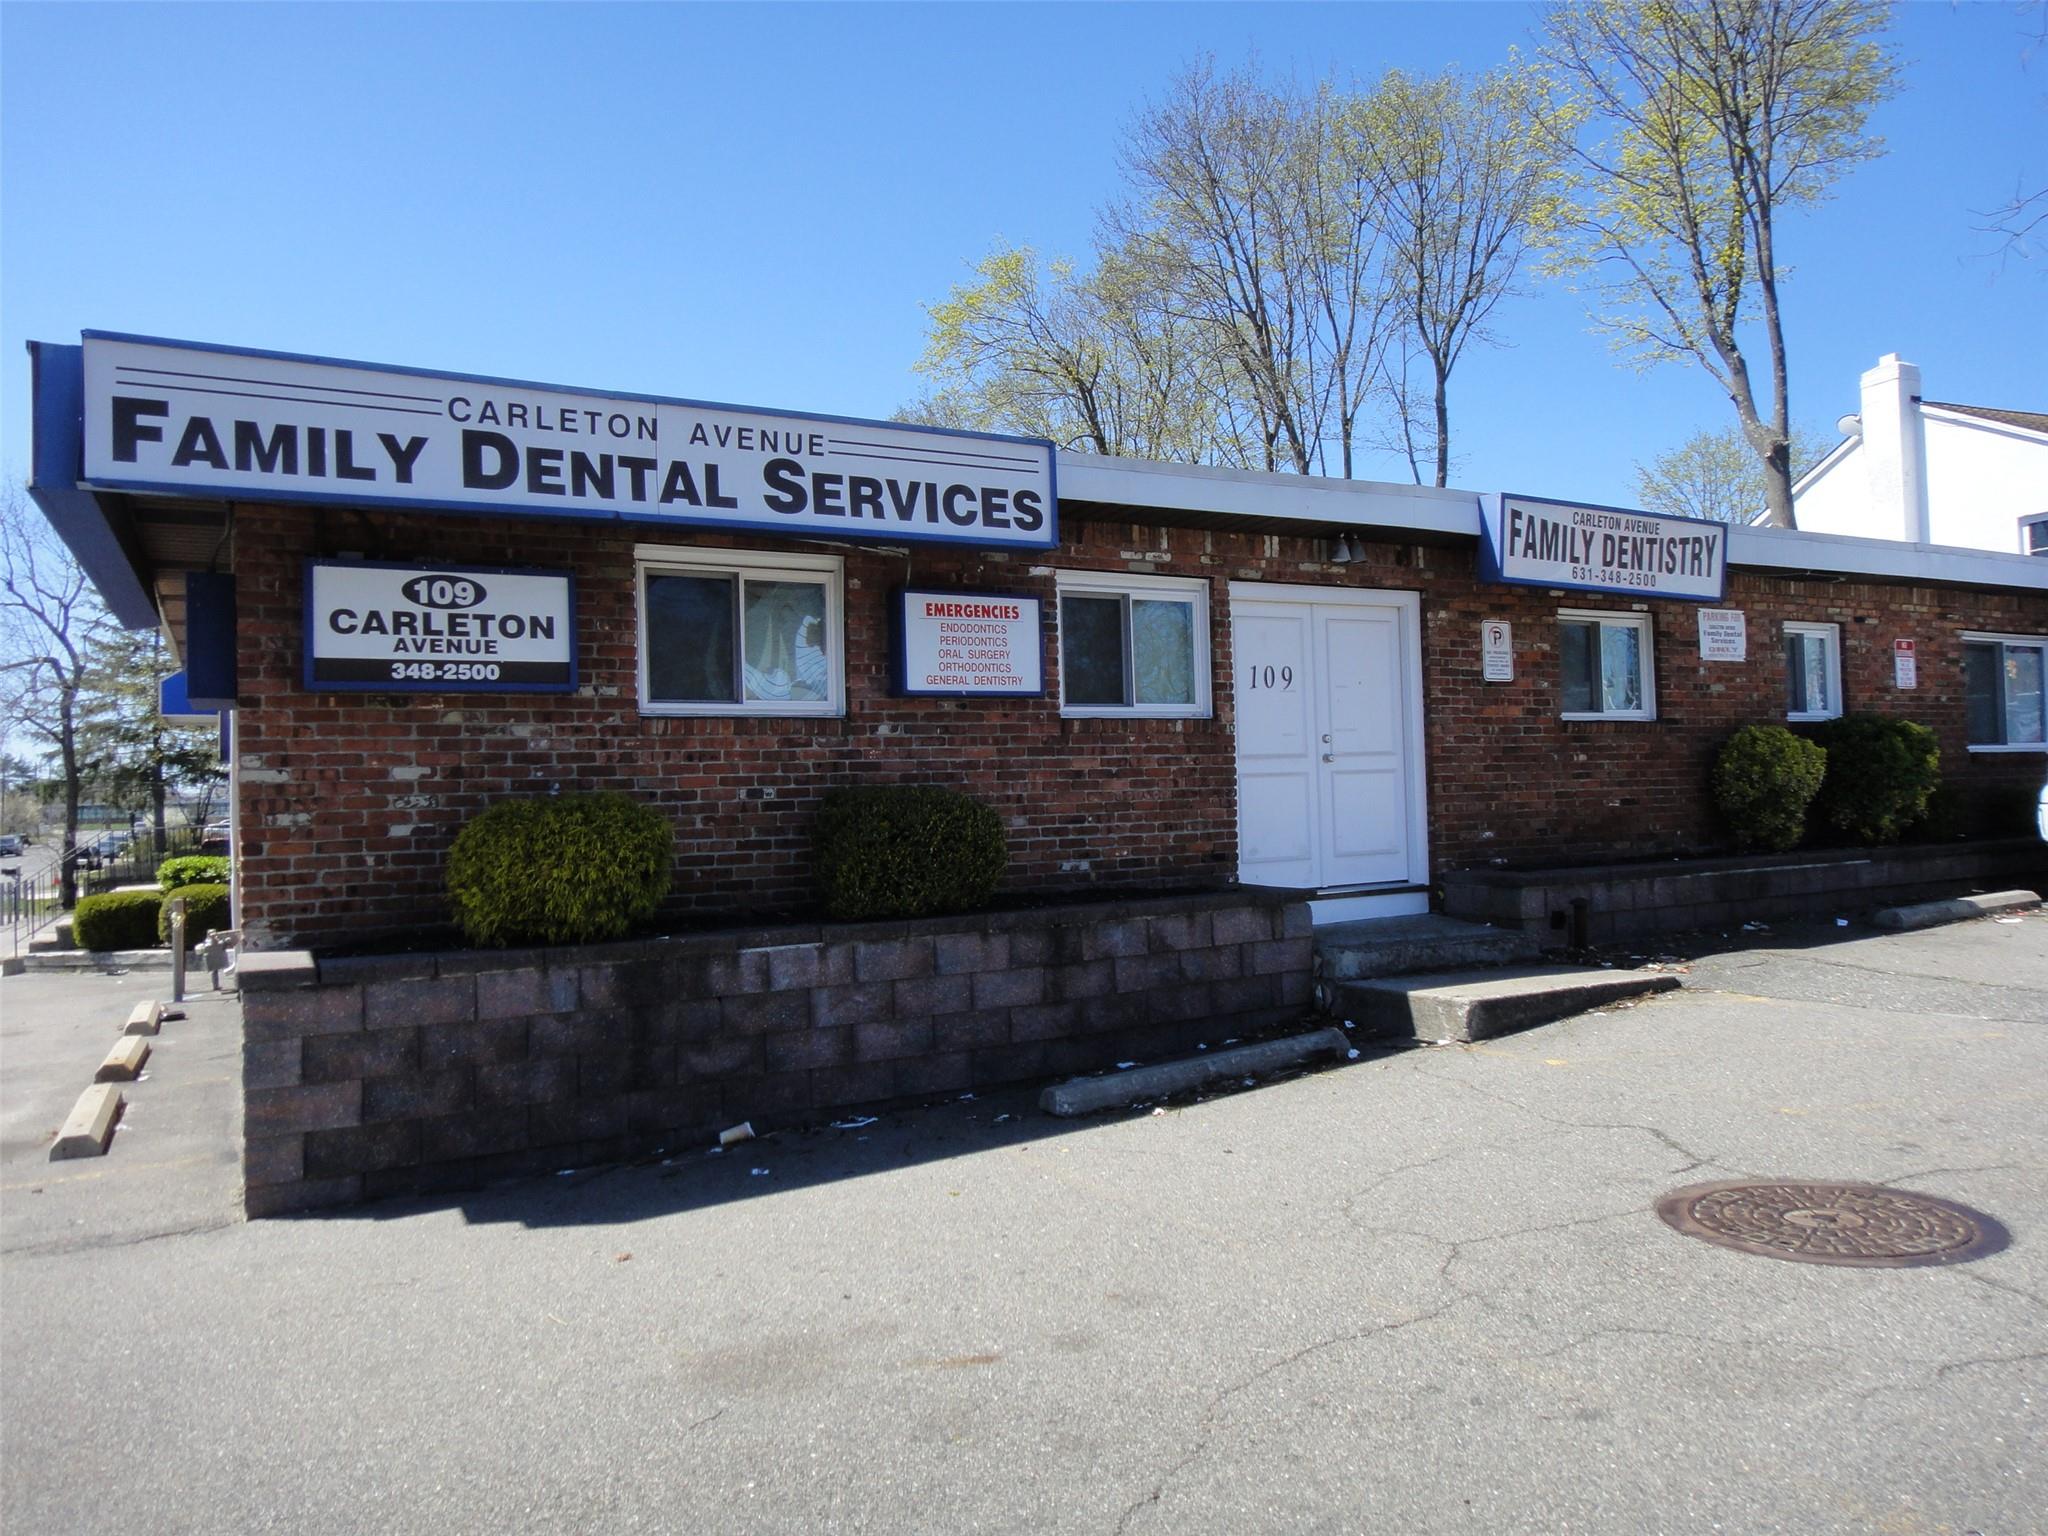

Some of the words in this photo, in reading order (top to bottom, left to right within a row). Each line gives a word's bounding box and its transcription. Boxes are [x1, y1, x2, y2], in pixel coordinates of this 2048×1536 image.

[447, 396, 658, 442] CARLETON
[689, 422, 826, 457] AVENUE
[111, 396, 428, 484] FAMILY
[462, 428, 738, 509] DENTAL
[762, 457, 1044, 532] SERVICES
[1572, 511, 1621, 530] CARLETON
[1624, 519, 1660, 536] AVENUE
[1509, 508, 1595, 565] FAMILY
[1602, 533, 1717, 578] DENTISTRY
[1572, 566, 1657, 588] 631-348-2500
[413, 579, 473, 606] 109
[925, 602, 1020, 619] EMERGENCIES
[328, 607, 555, 641] CARLETON
[940, 623, 1008, 634] ENDODONTICS
[392, 637, 498, 654] AVENUE
[939, 635, 1008, 647] PERIODONTICS
[938, 649, 963, 659] ORAL
[967, 649, 1011, 660] SURGERY
[391, 662, 500, 681] 348-2500
[938, 661, 1012, 673] ORTHODONTICS
[1249, 664, 1293, 690] 109
[926, 675, 970, 685] GENERAL
[973, 675, 1024, 686] DENTISTRY
